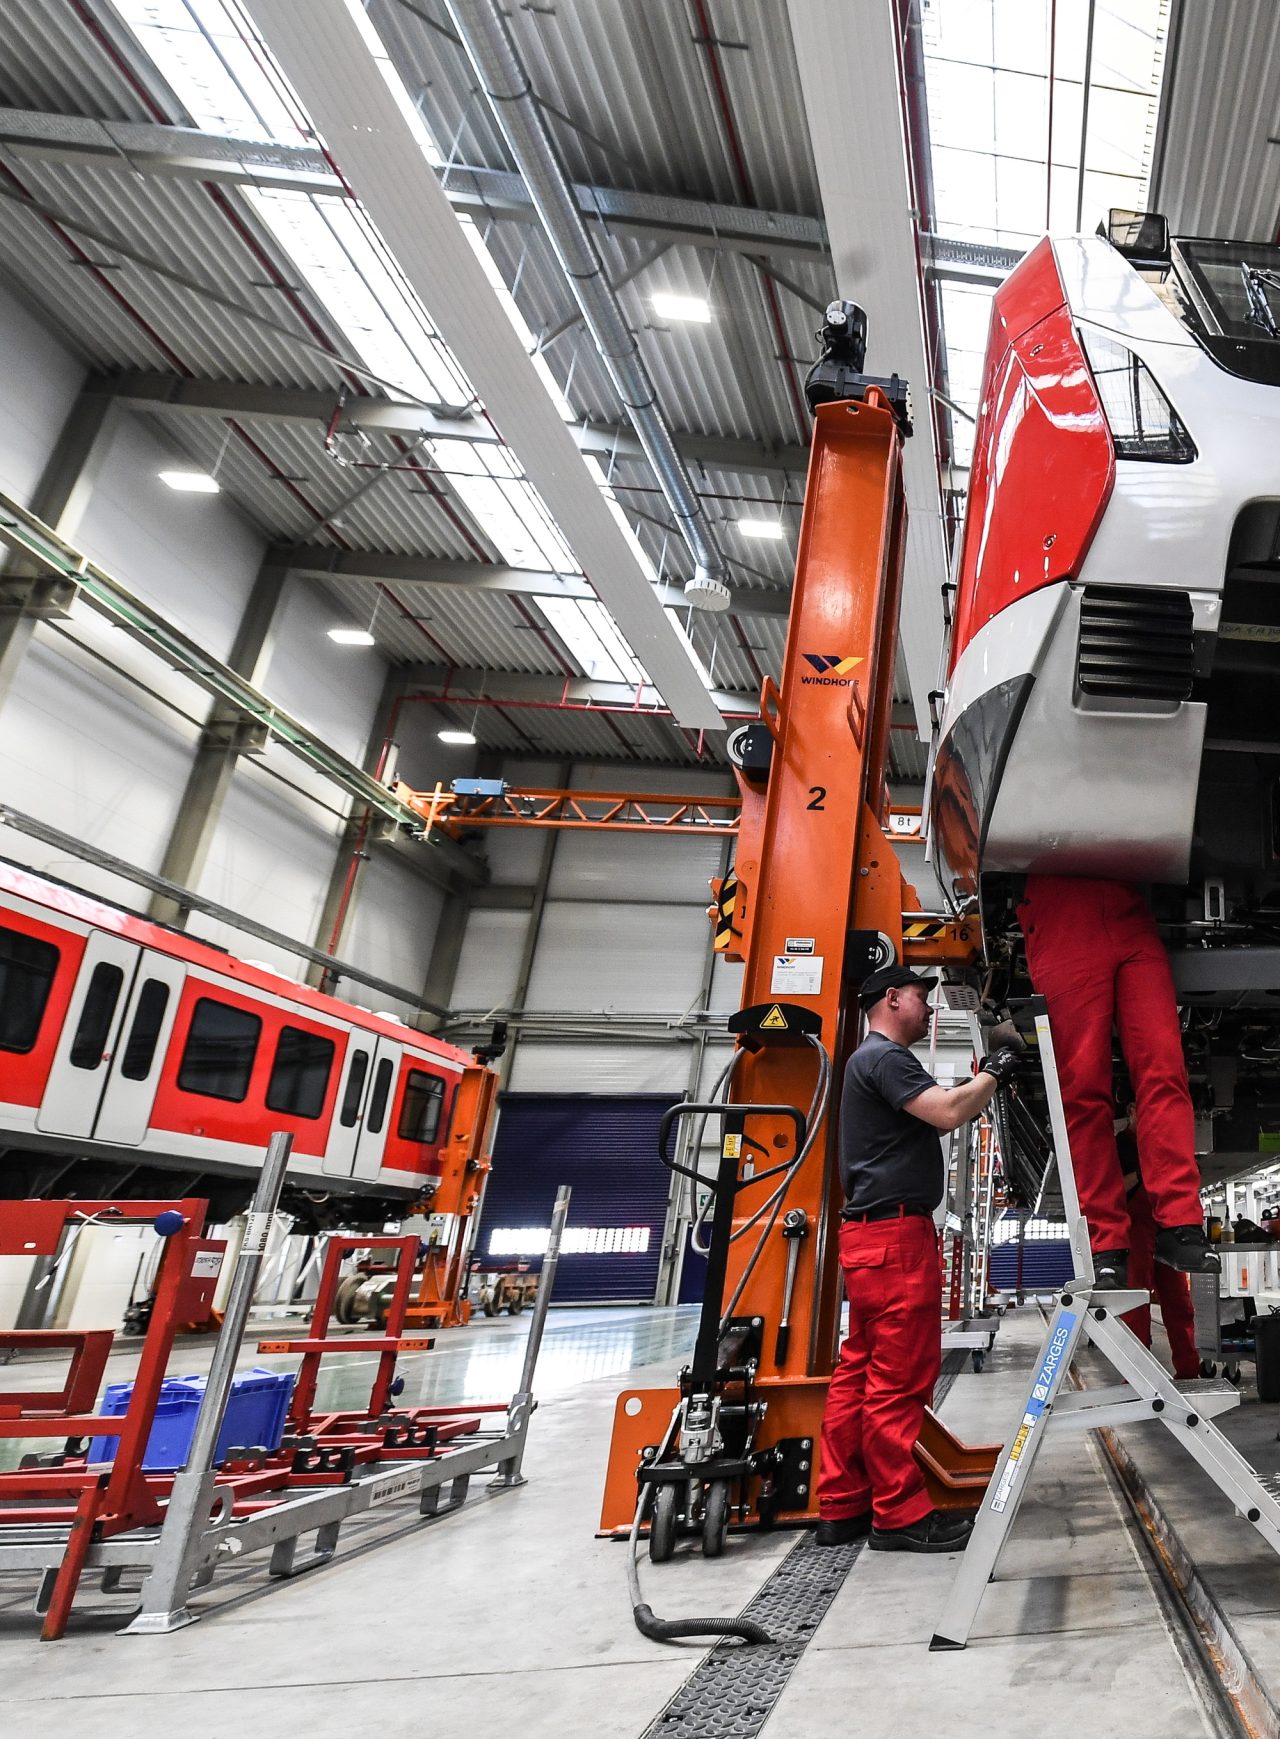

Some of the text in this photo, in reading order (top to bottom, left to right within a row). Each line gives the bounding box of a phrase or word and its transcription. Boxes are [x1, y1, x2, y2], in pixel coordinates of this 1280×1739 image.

[806, 786, 827, 811] 2
[897, 816, 911, 826] 8 t
[950, 928, 969, 941] 16
[265, 1213, 274, 1230] mm
[1039, 1327, 1069, 1385] ZARGES
